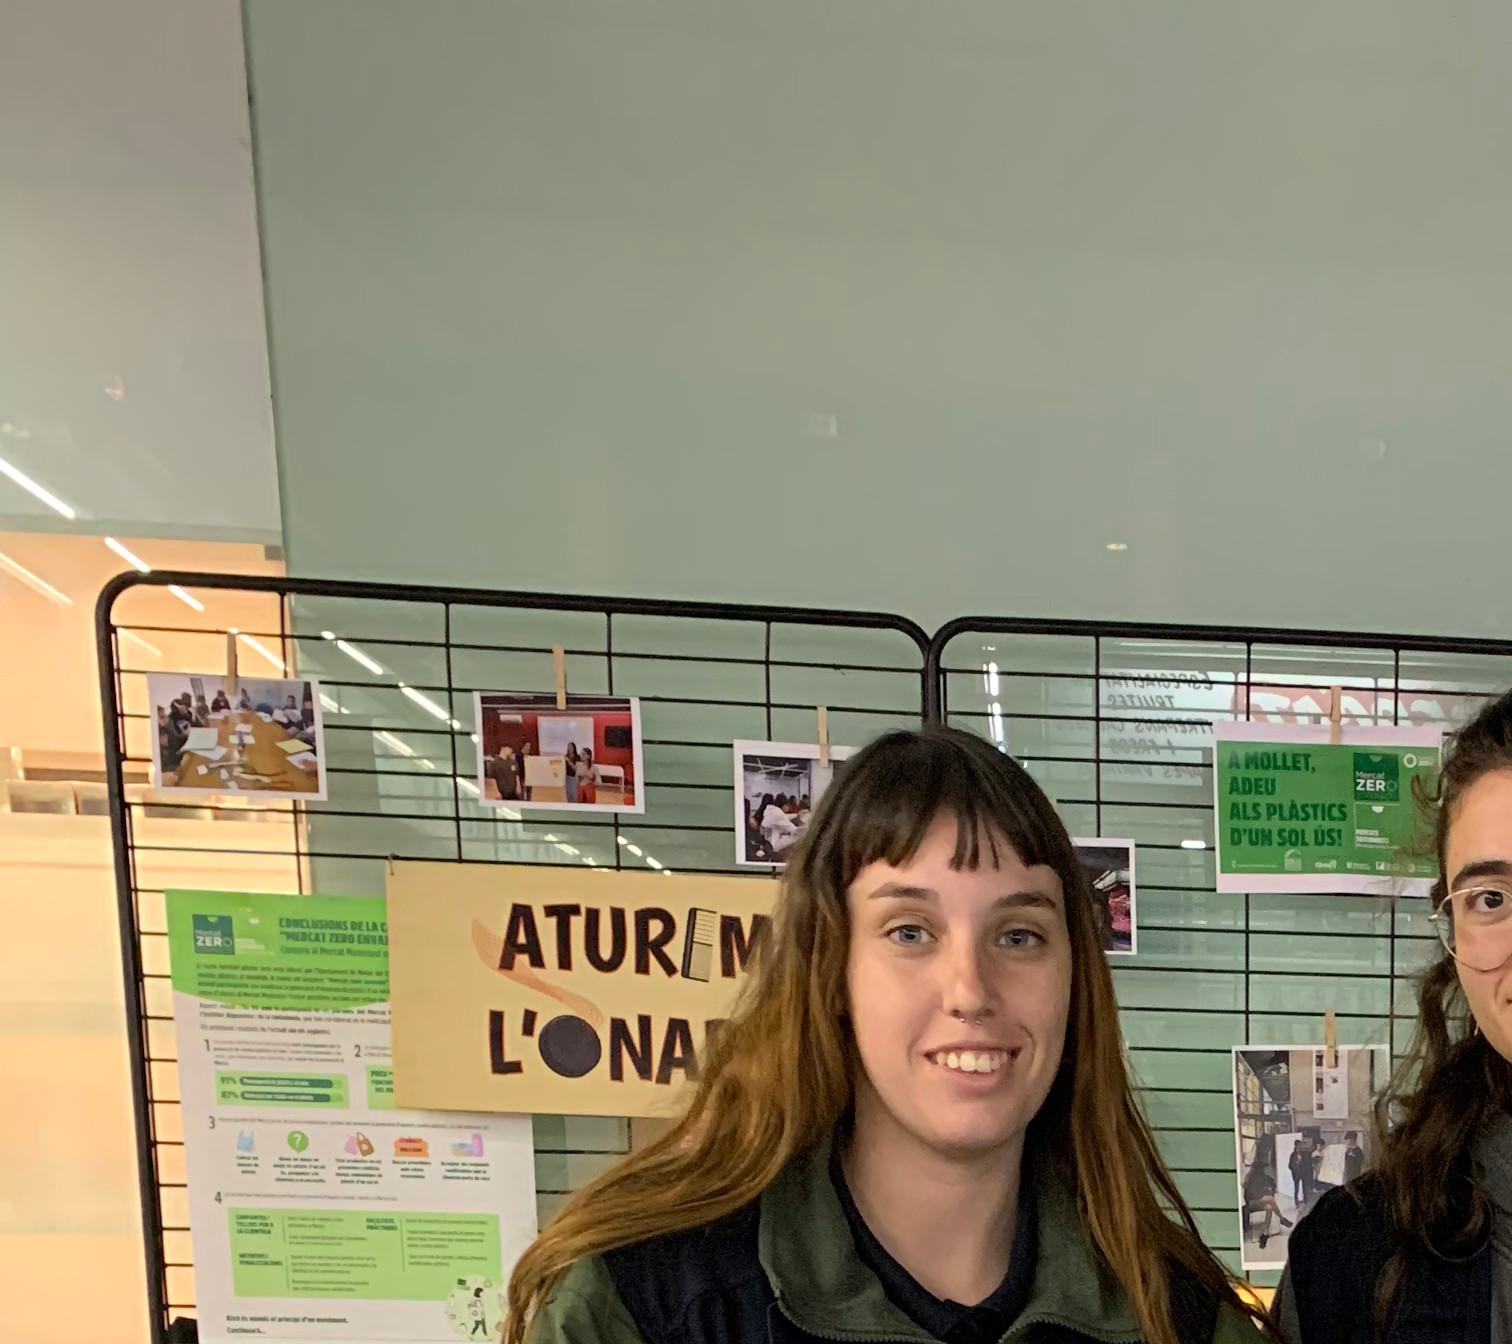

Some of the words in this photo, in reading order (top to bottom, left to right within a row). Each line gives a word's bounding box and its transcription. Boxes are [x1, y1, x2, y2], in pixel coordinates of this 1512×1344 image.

[1228, 751, 1240, 769] A
[1244, 751, 1316, 774] MOLLET,
[1228, 776, 1277, 796] ADEU
[1230, 802, 1262, 821] ALS
[1265, 799, 1348, 821] PLÀSTICS
[1230, 827, 1273, 847] D'UN
[1277, 828, 1310, 847] SOL
[1313, 824, 1343, 847] ÚS!
[279, 918, 349, 930] CONCLUSIONS
[354, 1045, 361, 1057] 2
[208, 1116, 216, 1129] 3
